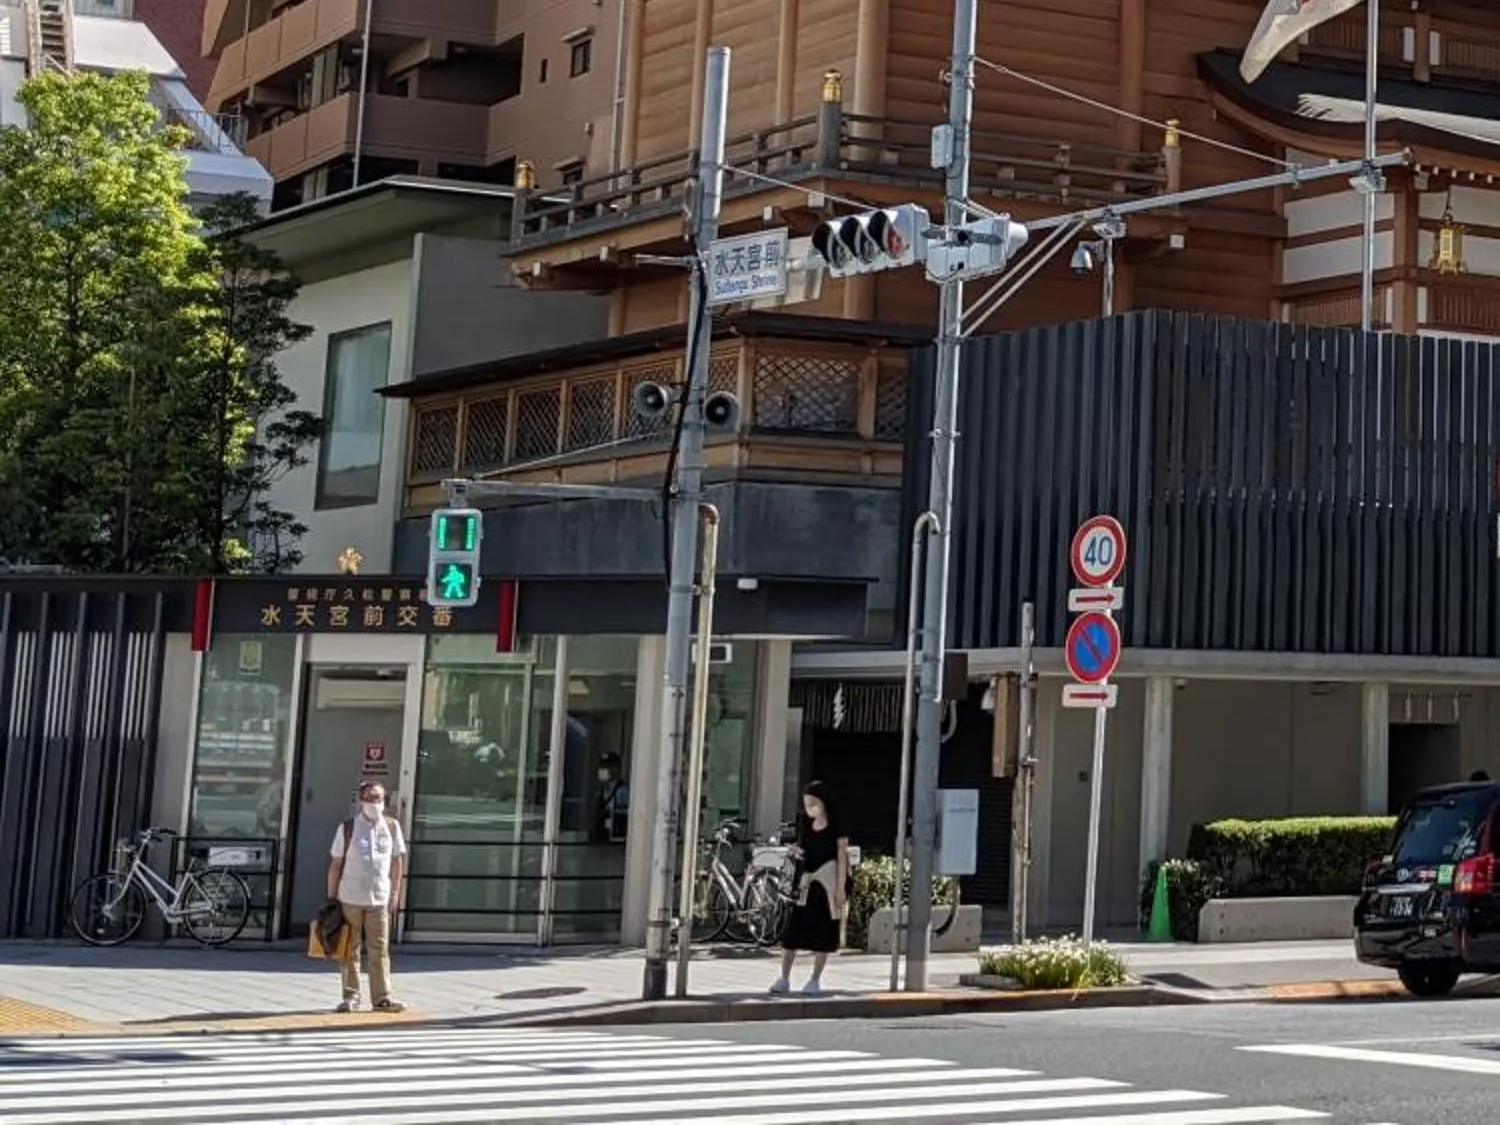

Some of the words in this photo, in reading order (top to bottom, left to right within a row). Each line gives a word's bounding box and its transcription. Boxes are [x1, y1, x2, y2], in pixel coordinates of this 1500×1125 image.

[715, 240, 780, 275] 水天宮前
[1084, 536, 1113, 566] 40
[261, 604, 453, 627] 水天宮前交番
